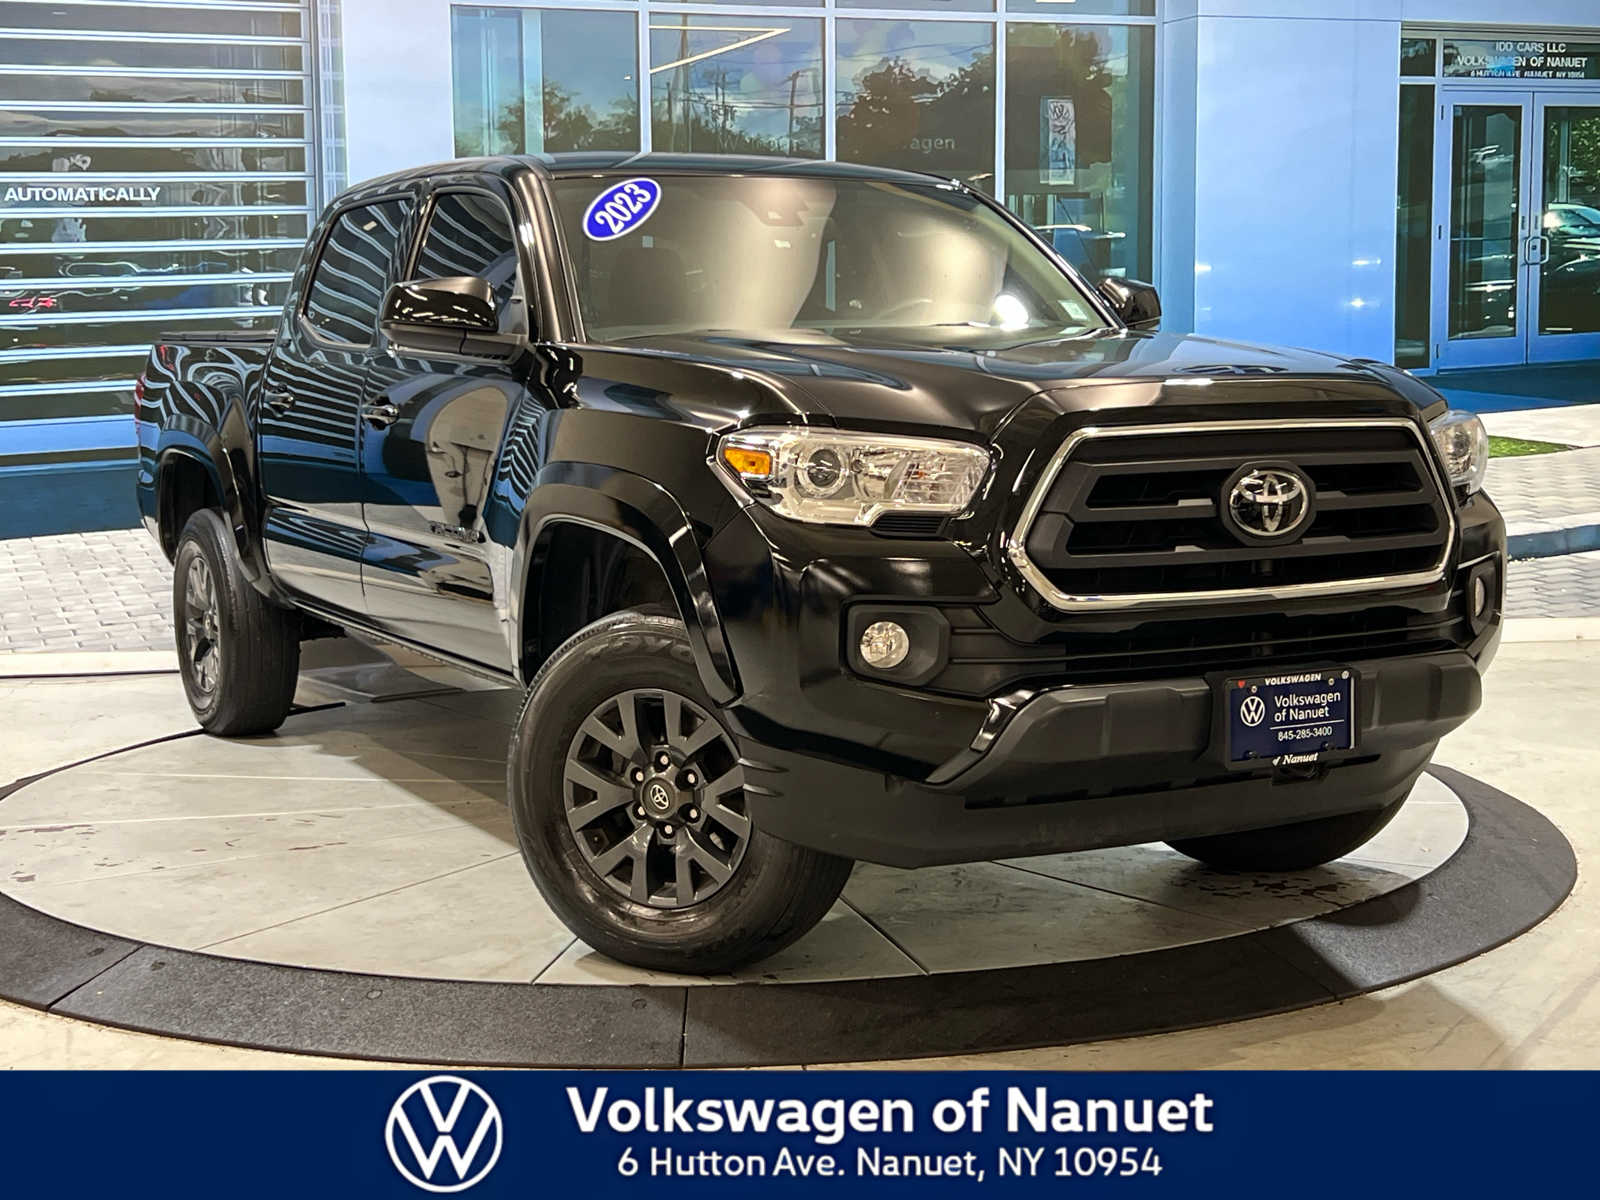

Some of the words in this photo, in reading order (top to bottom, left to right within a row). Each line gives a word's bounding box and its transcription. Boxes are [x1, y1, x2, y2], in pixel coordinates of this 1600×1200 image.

[1516, 42, 1545, 53] CARS
[1547, 43, 1566, 53] LLC
[1457, 55, 1526, 67] VOLKSEN
[1530, 57, 1544, 68] OF
[1547, 57, 1588, 68] NANUET
[4, 186, 161, 201] AUTOMATICALLY
[594, 183, 652, 235] 2023
[1264, 673, 1322, 686] VOLKSWAGEN
[1274, 692, 1341, 708] Volkswagen
[1274, 709, 1287, 722] of
[1289, 706, 1330, 720] Nanuet
[1278, 726, 1333, 741] 845-285-3400
[1282, 752, 1319, 765] Nanuet
